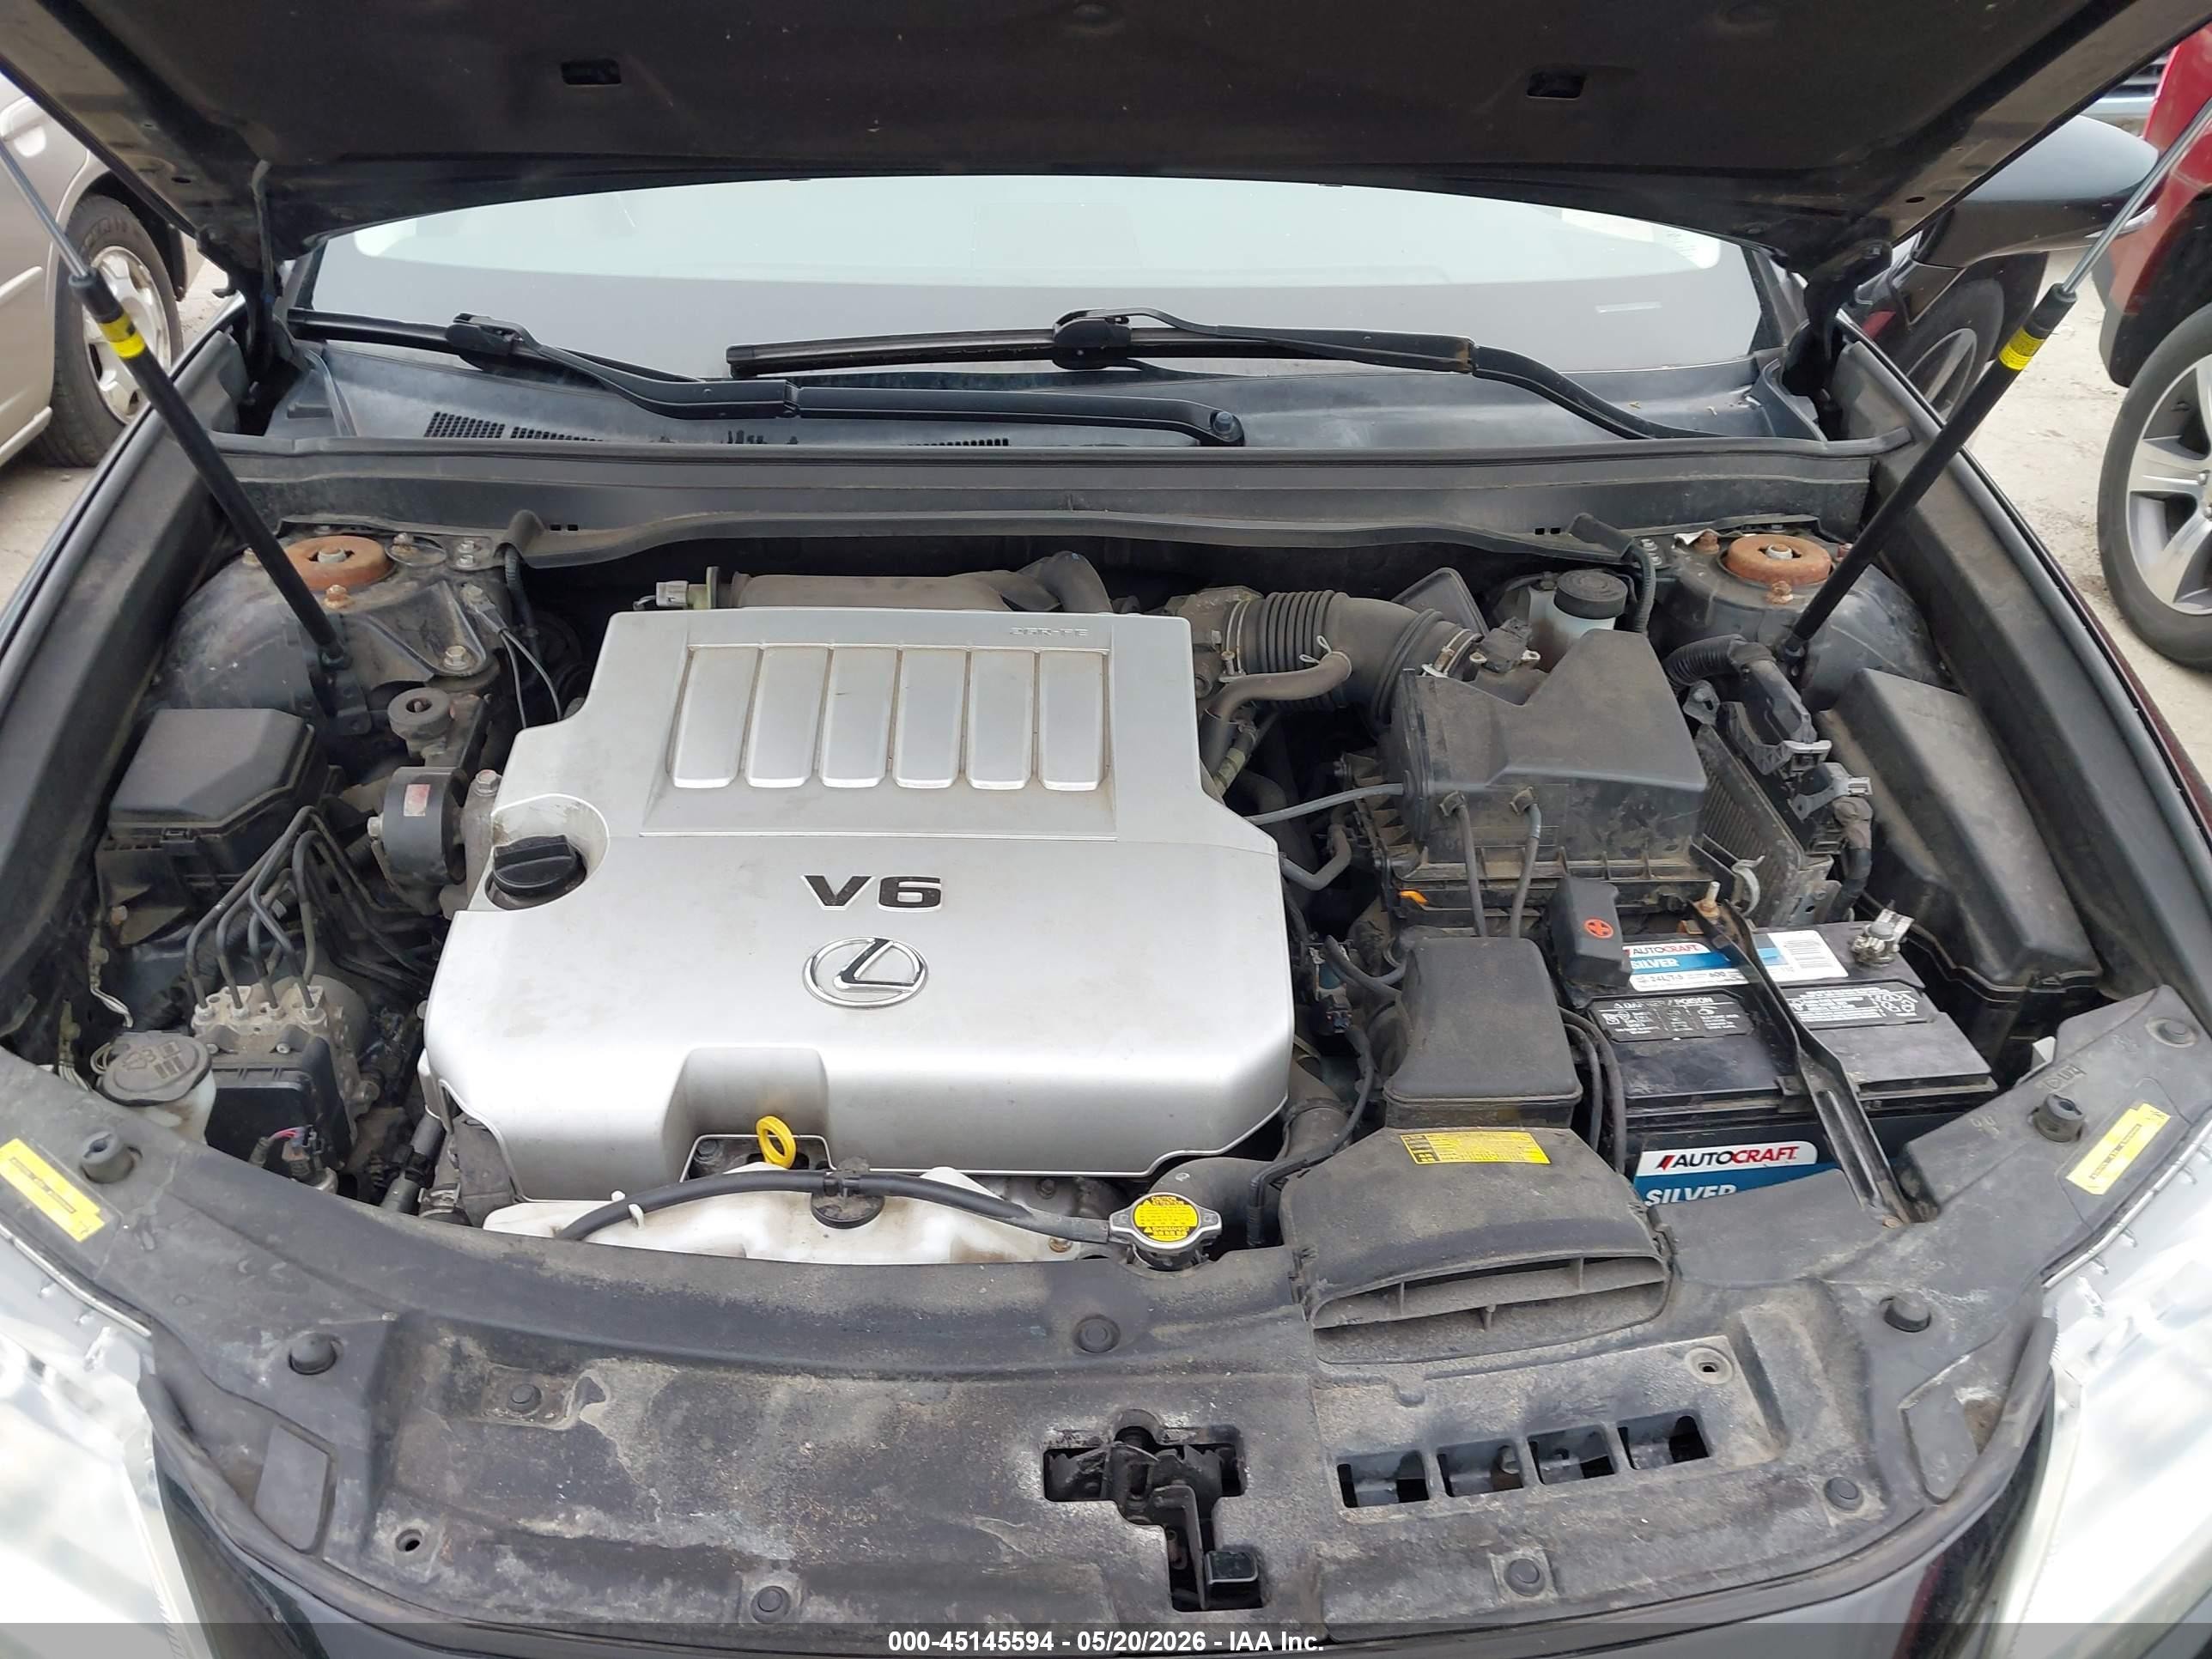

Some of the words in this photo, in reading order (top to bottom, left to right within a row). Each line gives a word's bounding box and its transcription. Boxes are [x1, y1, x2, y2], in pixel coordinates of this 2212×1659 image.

[801, 875, 942, 912] V6
[1633, 945, 1698, 955] AUTOCRAFT
[1631, 957, 1680, 969] SILVER
[1674, 997, 1714, 1006] POISON
[1671, 1146, 1800, 1168] AUTOCRAFT
